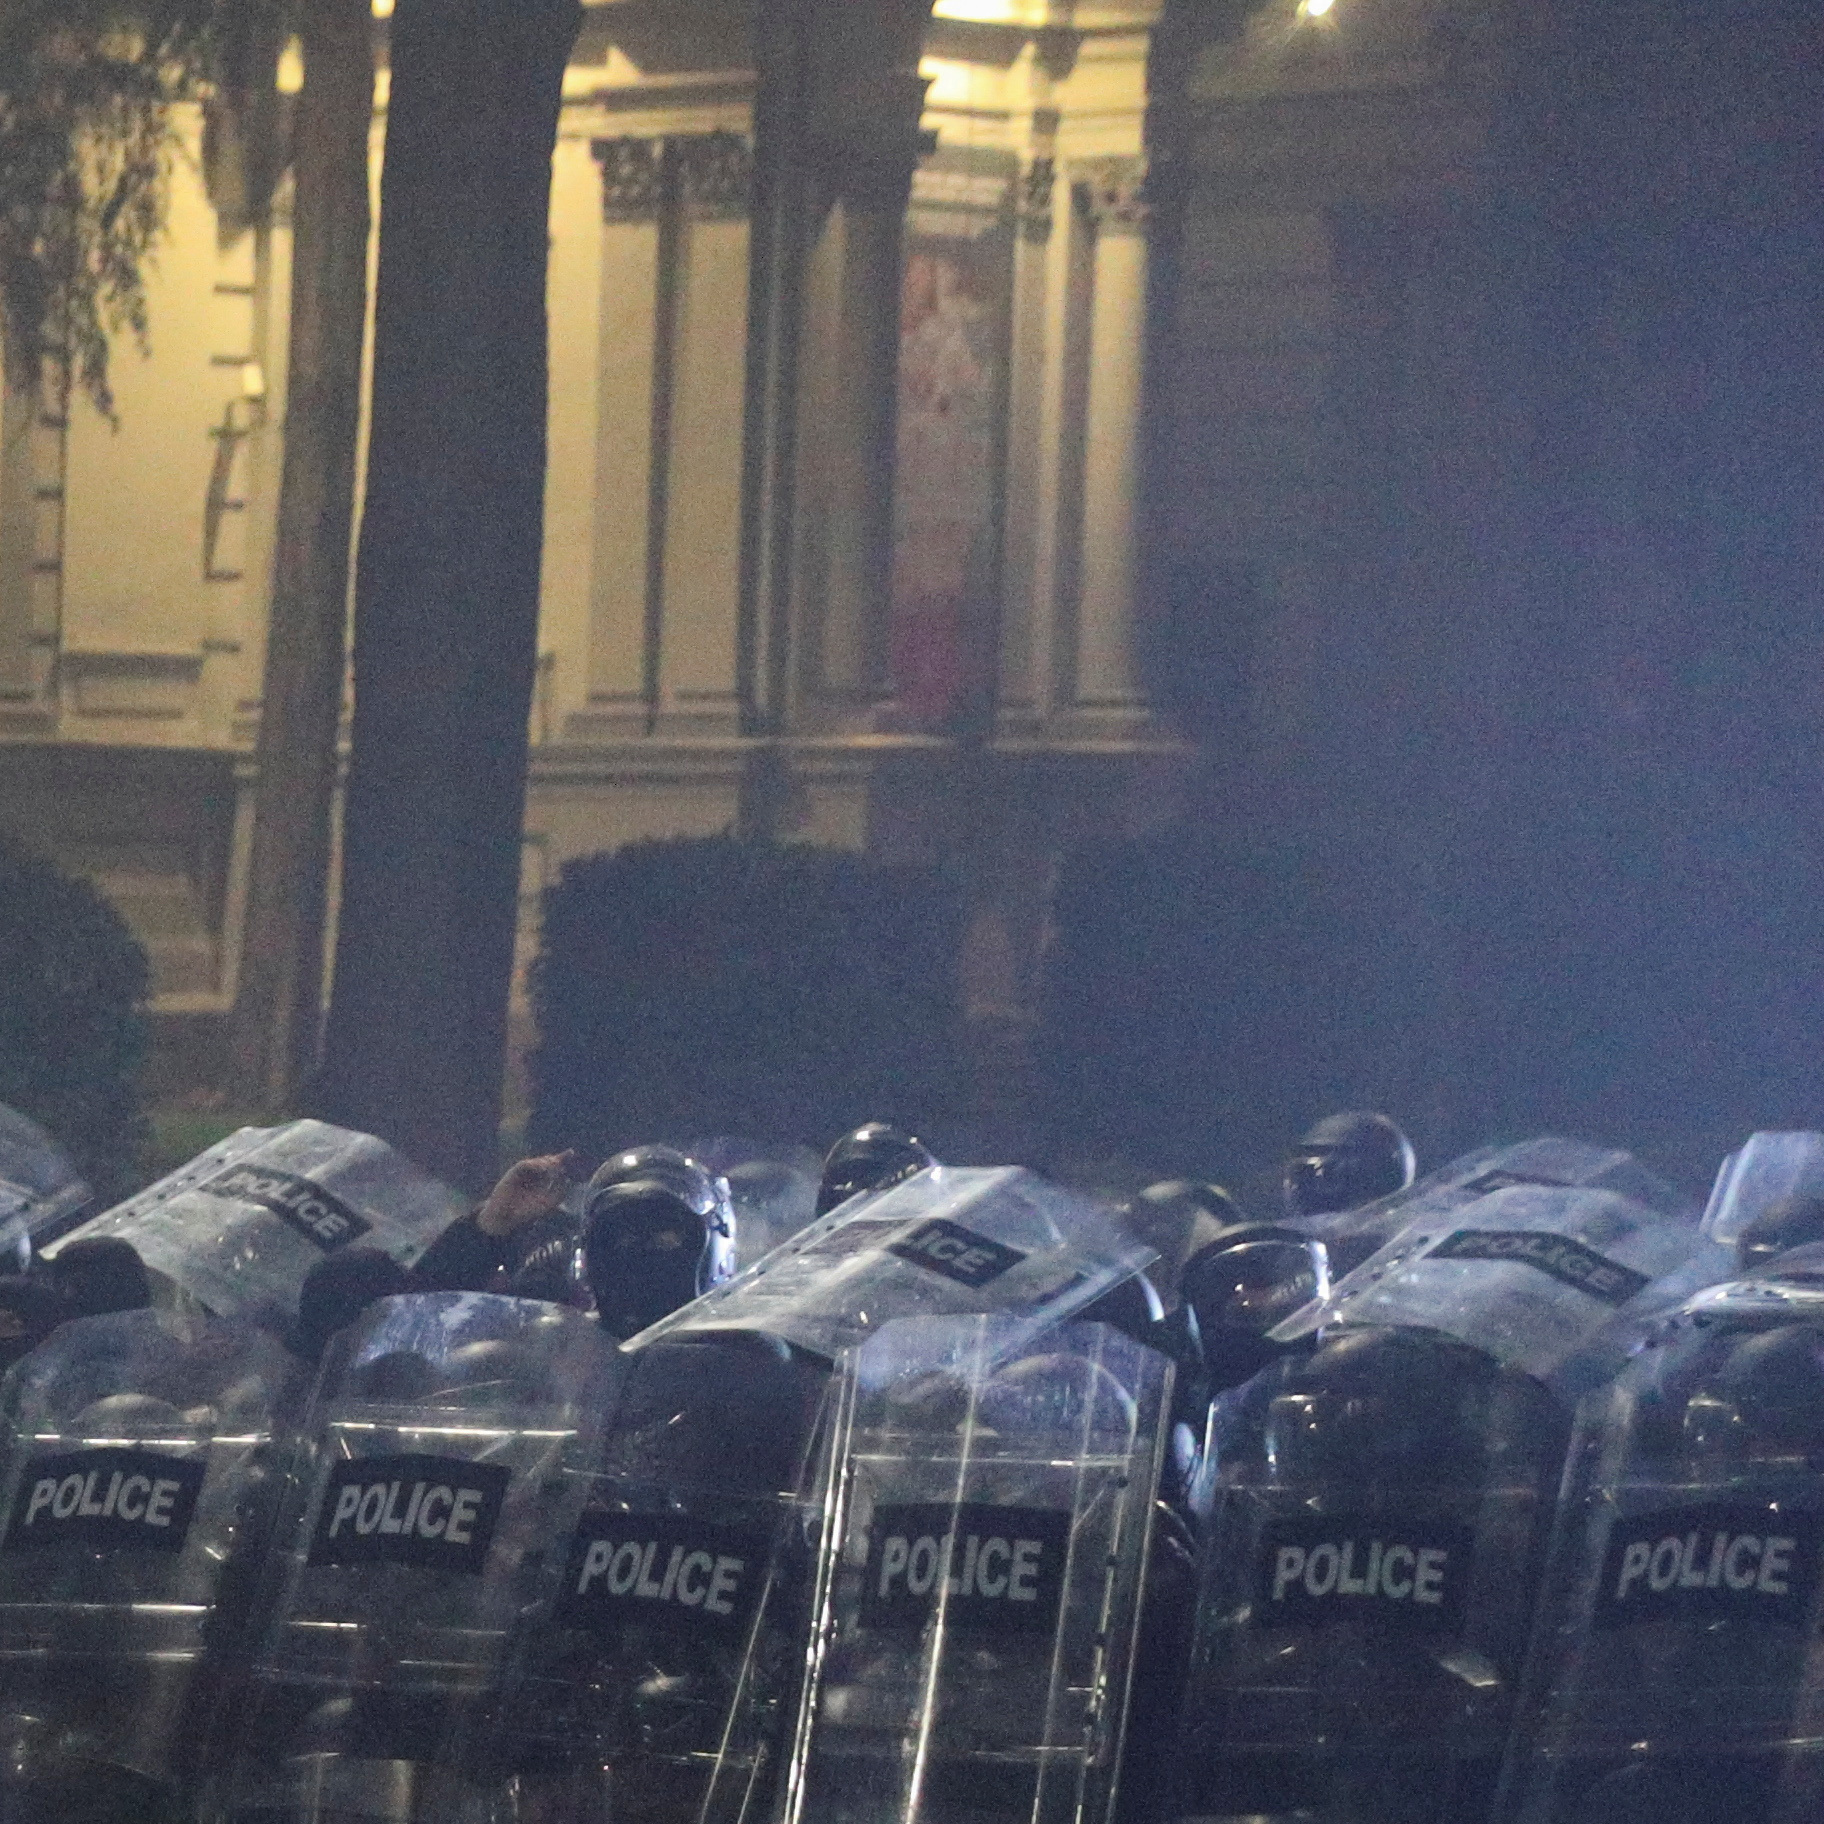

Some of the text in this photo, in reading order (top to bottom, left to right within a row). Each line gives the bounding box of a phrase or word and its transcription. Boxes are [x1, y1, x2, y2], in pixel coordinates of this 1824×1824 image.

[24, 1471, 181, 1527] POLICE
[329, 1481, 483, 1545] POLICE
[577, 1539, 744, 1617] POLICE
[877, 1534, 1042, 1602] POLICE
[1272, 1540, 1447, 1605] POLICE
[1615, 1531, 1796, 1600] POLICE
